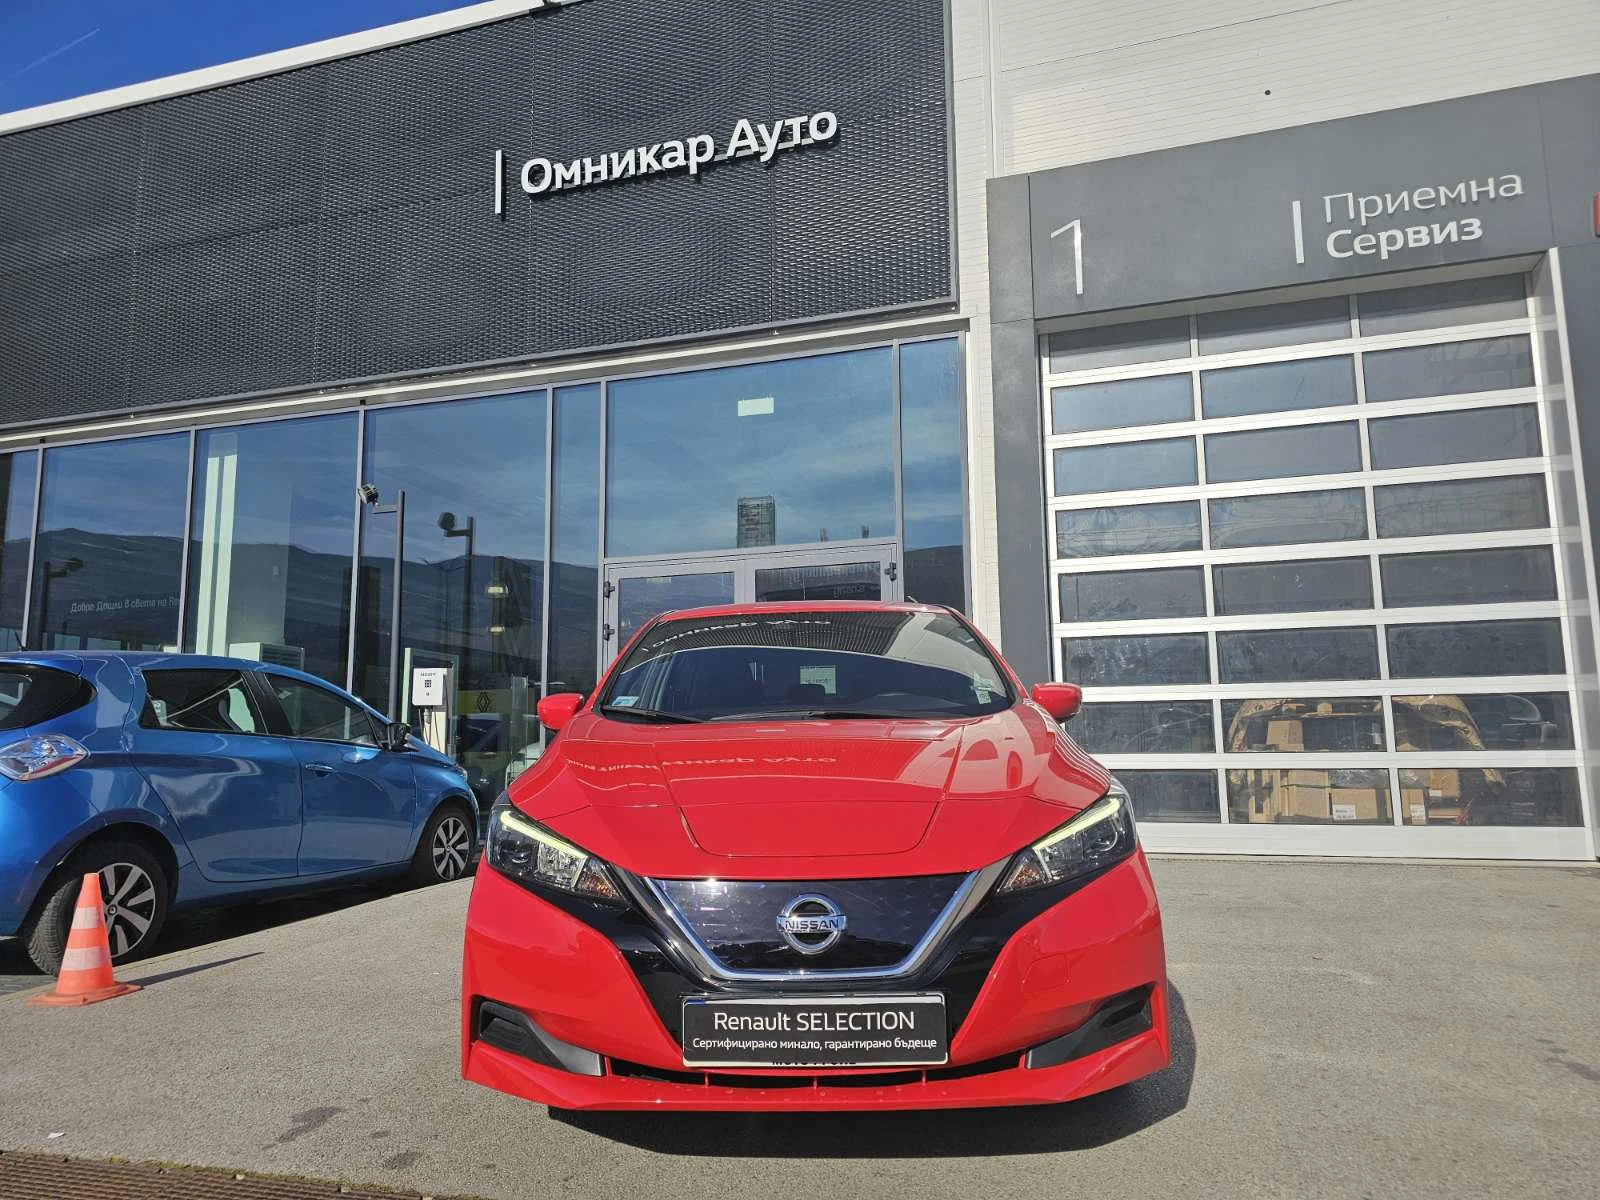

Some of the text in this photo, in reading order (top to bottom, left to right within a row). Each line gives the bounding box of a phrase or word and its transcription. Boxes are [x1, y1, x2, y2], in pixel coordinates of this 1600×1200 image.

[520, 111, 838, 194] Омникар Ауто
[1323, 173, 1524, 227] Приемна
[1050, 219, 1085, 296] 1
[1326, 216, 1483, 260] Сервиз
[786, 920, 839, 929] NISSAN
[713, 1011, 915, 1032] Renault SELECTION
[692, 1037, 937, 1052] Сертифицирано минало, гарантирано бъдеще
